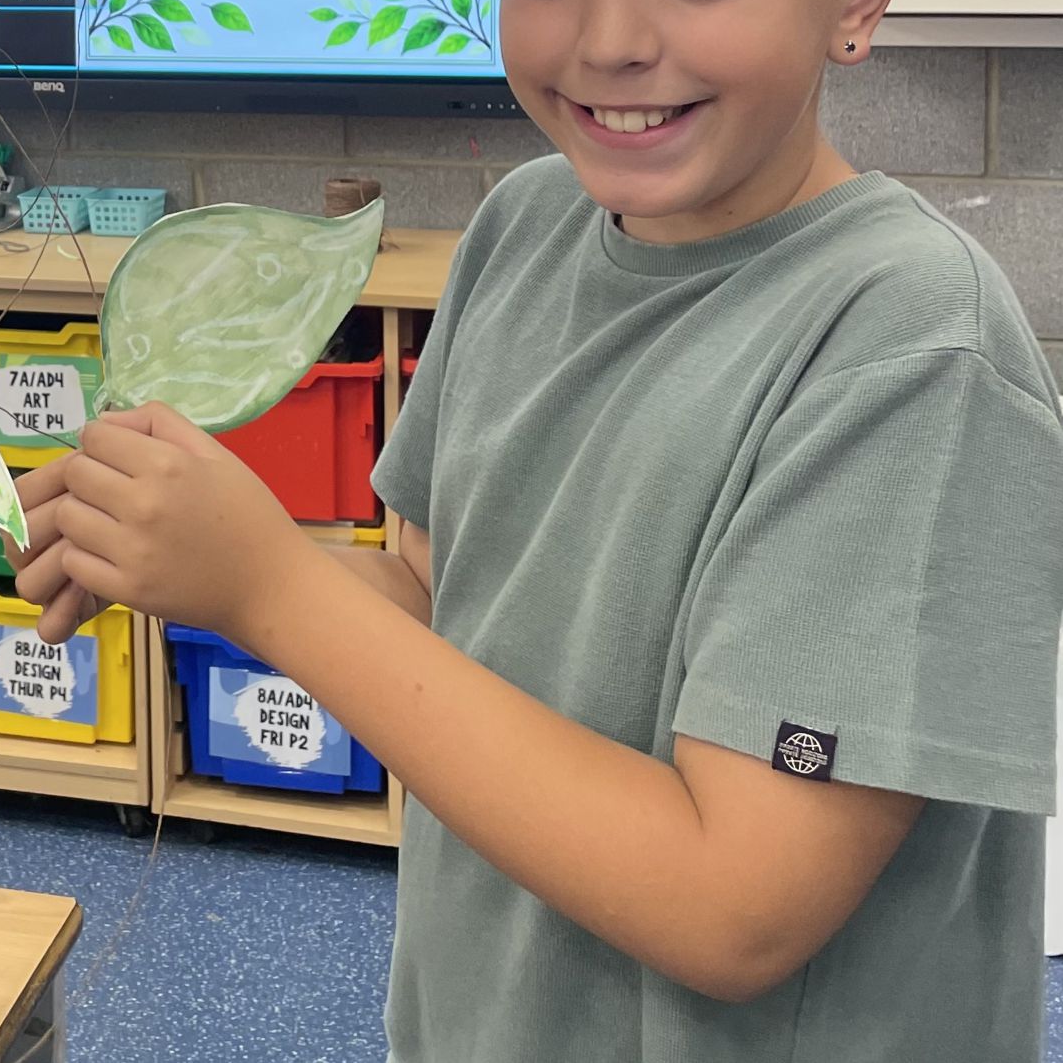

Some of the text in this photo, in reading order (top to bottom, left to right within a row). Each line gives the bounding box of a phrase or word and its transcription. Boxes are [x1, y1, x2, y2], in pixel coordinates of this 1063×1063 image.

[10, 371, 64, 388] 7A/AD4
[23, 392, 50, 408] ART
[13, 412, 64, 429] TUE P4
[15, 641, 61, 662] 8B/AD1
[15, 660, 61, 681] DESIGN
[9, 679, 67, 702] THUR P4
[257, 687, 313, 711] 8A/AD4
[260, 708, 309, 730] DESIGN
[260, 728, 309, 751] FRI P2
